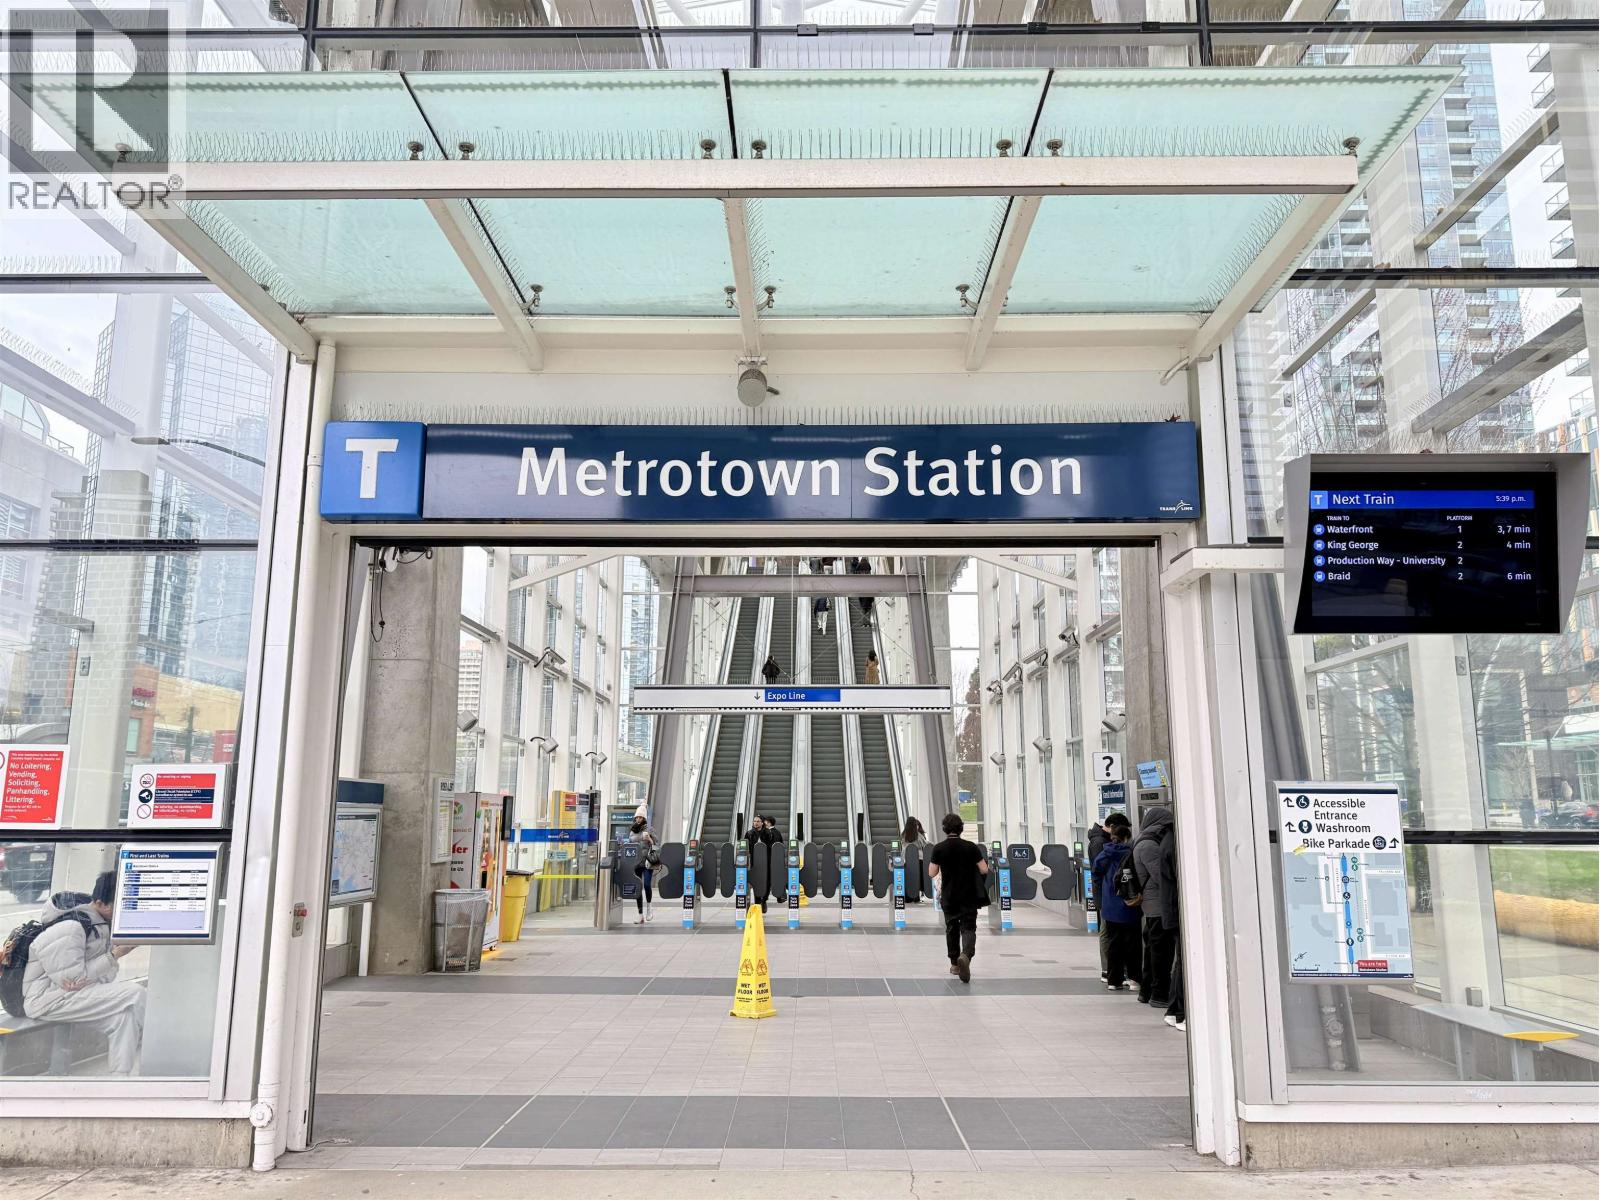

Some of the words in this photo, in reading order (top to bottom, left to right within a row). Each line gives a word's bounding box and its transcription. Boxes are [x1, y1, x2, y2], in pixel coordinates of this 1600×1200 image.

[345, 438, 399, 499] T
[516, 446, 840, 498] Metrotown
[863, 443, 1083, 497] Station
[1332, 494, 1360, 505] Next
[1363, 493, 1395, 505] Train
[1326, 525, 1374, 534] Waterfront
[1457, 525, 1463, 534] 1
[1497, 525, 1505, 535] 3,
[1506, 525, 1512, 534] 7
[1514, 524, 1531, 534] min
[1327, 541, 1347, 551] King
[1348, 541, 1379, 551] George
[1457, 541, 1463, 549] 2
[1506, 541, 1512, 549] 4
[1514, 540, 1531, 549] min
[1327, 556, 1375, 565] Production
[1376, 556, 1395, 566] Way
[1402, 556, 1447, 567] University
[1457, 556, 1463, 565] 2
[1328, 572, 1351, 581] Braid
[1458, 572, 1463, 581] 2
[1507, 572, 1513, 581] 6
[1515, 572, 1532, 581] min
[767, 691, 787, 701] Expo
[788, 691, 806, 700] Line
[20, 762, 52, 771] Loitering,
[1313, 798, 1366, 808] Accessible
[1314, 811, 1358, 820] Entrance
[1315, 823, 1371, 833] Washroom
[1302, 839, 1325, 848] Bike
[1328, 839, 1370, 849] Parkade
